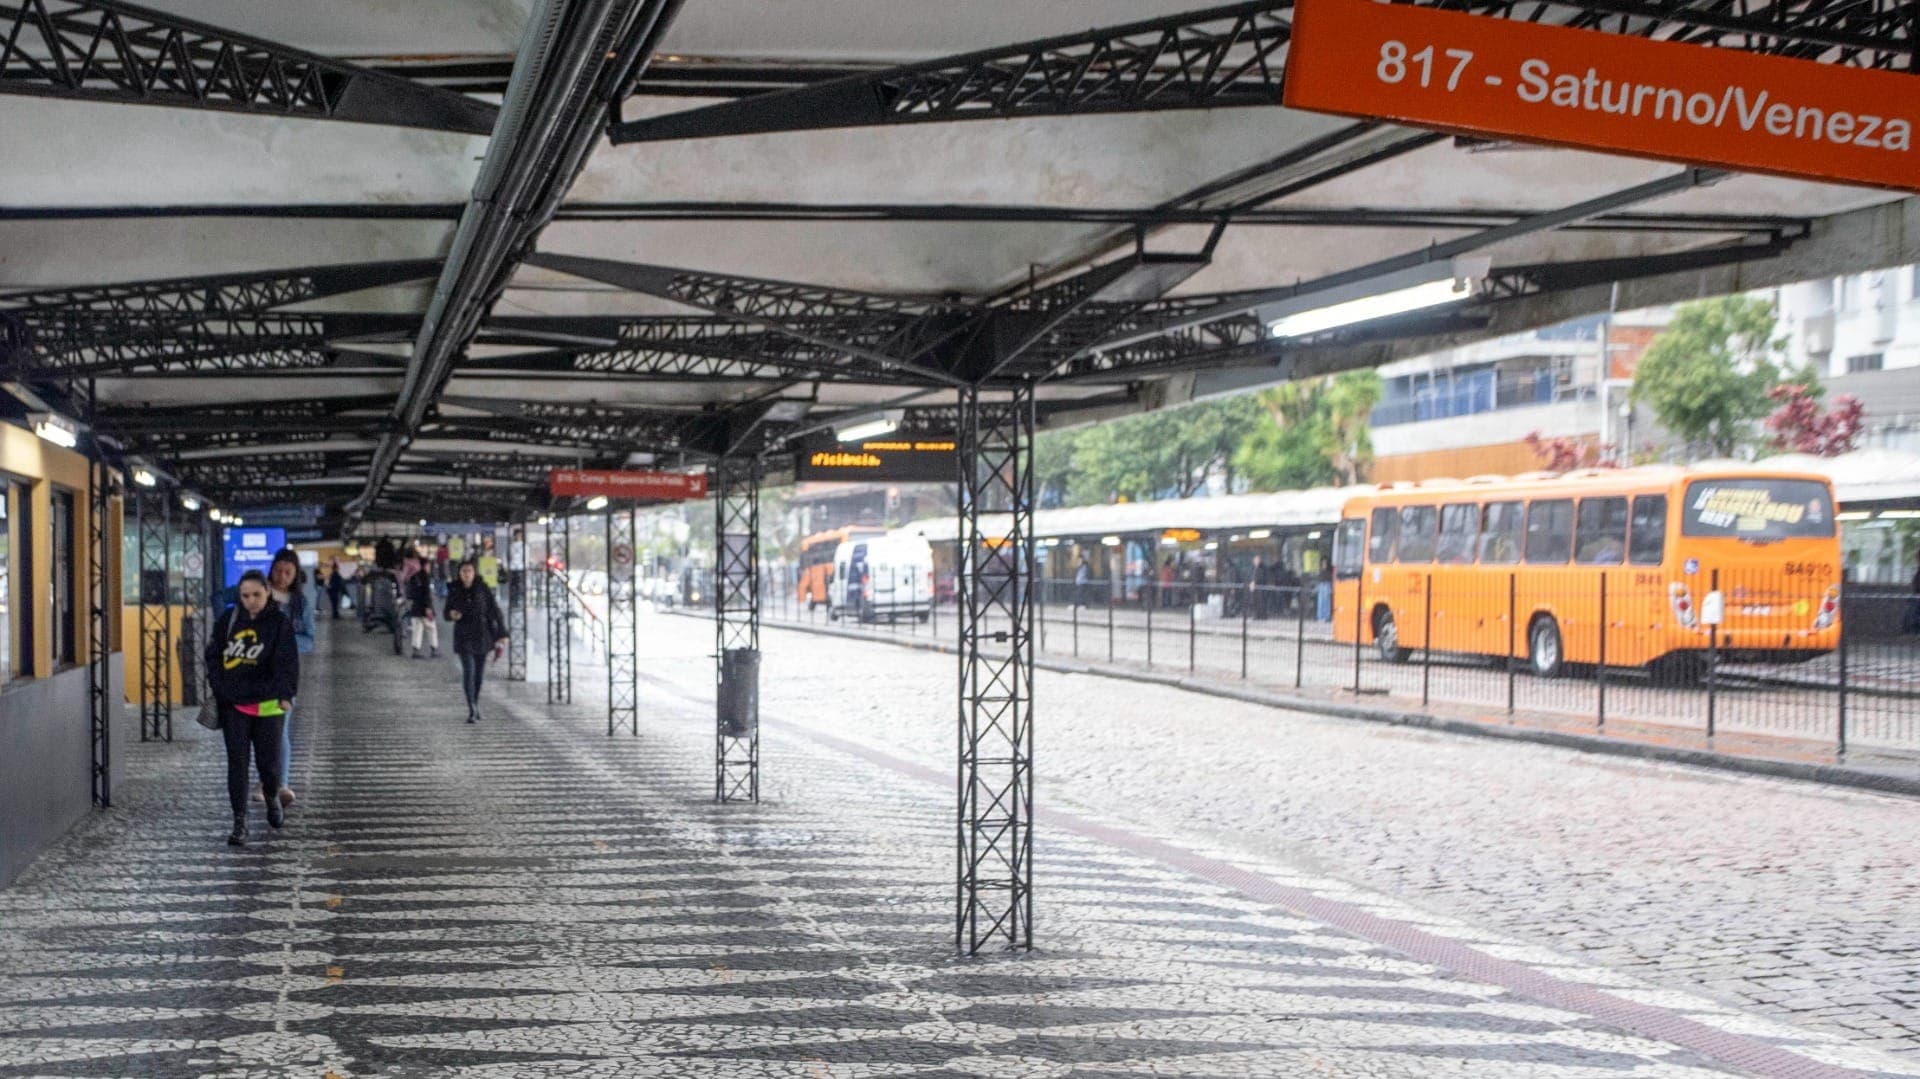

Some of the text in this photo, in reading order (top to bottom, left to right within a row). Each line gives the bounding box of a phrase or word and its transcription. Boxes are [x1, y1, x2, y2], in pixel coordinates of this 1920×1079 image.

[1376, 40, 1912, 152] 817 - Saturno/Veneza
